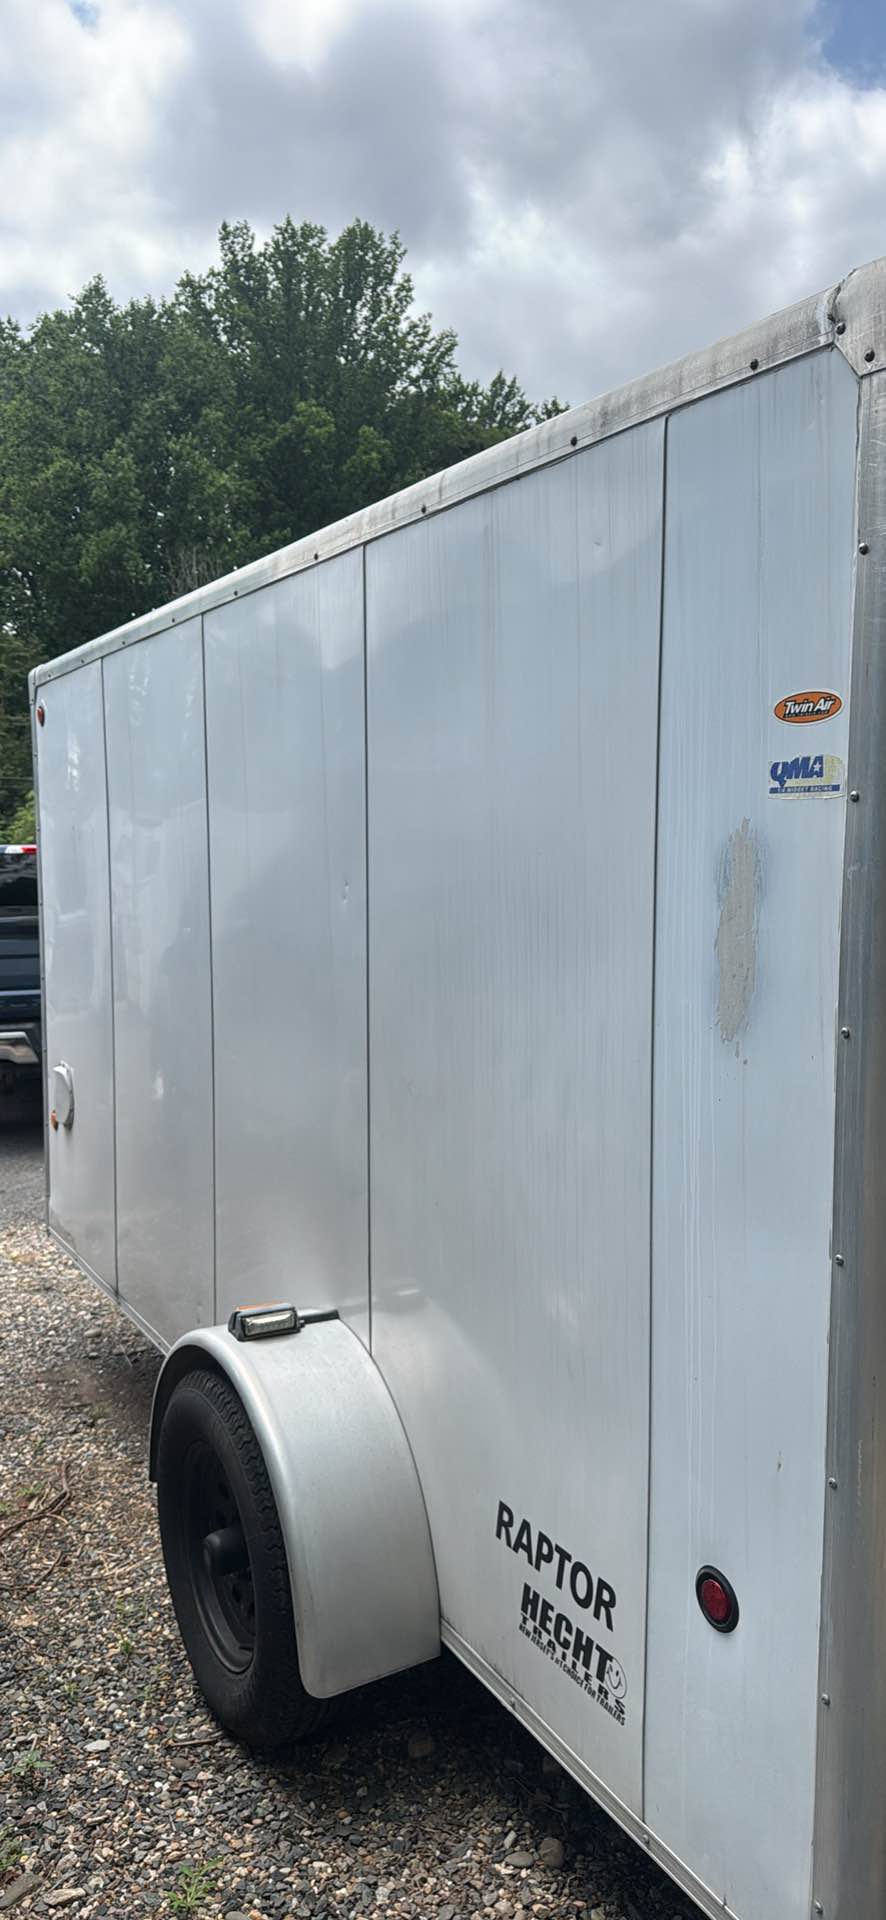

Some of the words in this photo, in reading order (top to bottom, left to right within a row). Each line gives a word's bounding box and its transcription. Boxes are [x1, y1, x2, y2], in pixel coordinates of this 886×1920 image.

[785, 699, 814, 714] Twin
[814, 697, 835, 712] Air
[770, 754, 824, 787] QMA
[495, 1500, 617, 1632] RAPTOR
[519, 1623, 531, 1640] NEW
[563, 1663, 584, 1688] CHOICE
[596, 1694, 626, 1726] TRAILERS
[520, 1612, 626, 1715] TRAILERS
[521, 1582, 614, 1683] HECHT
